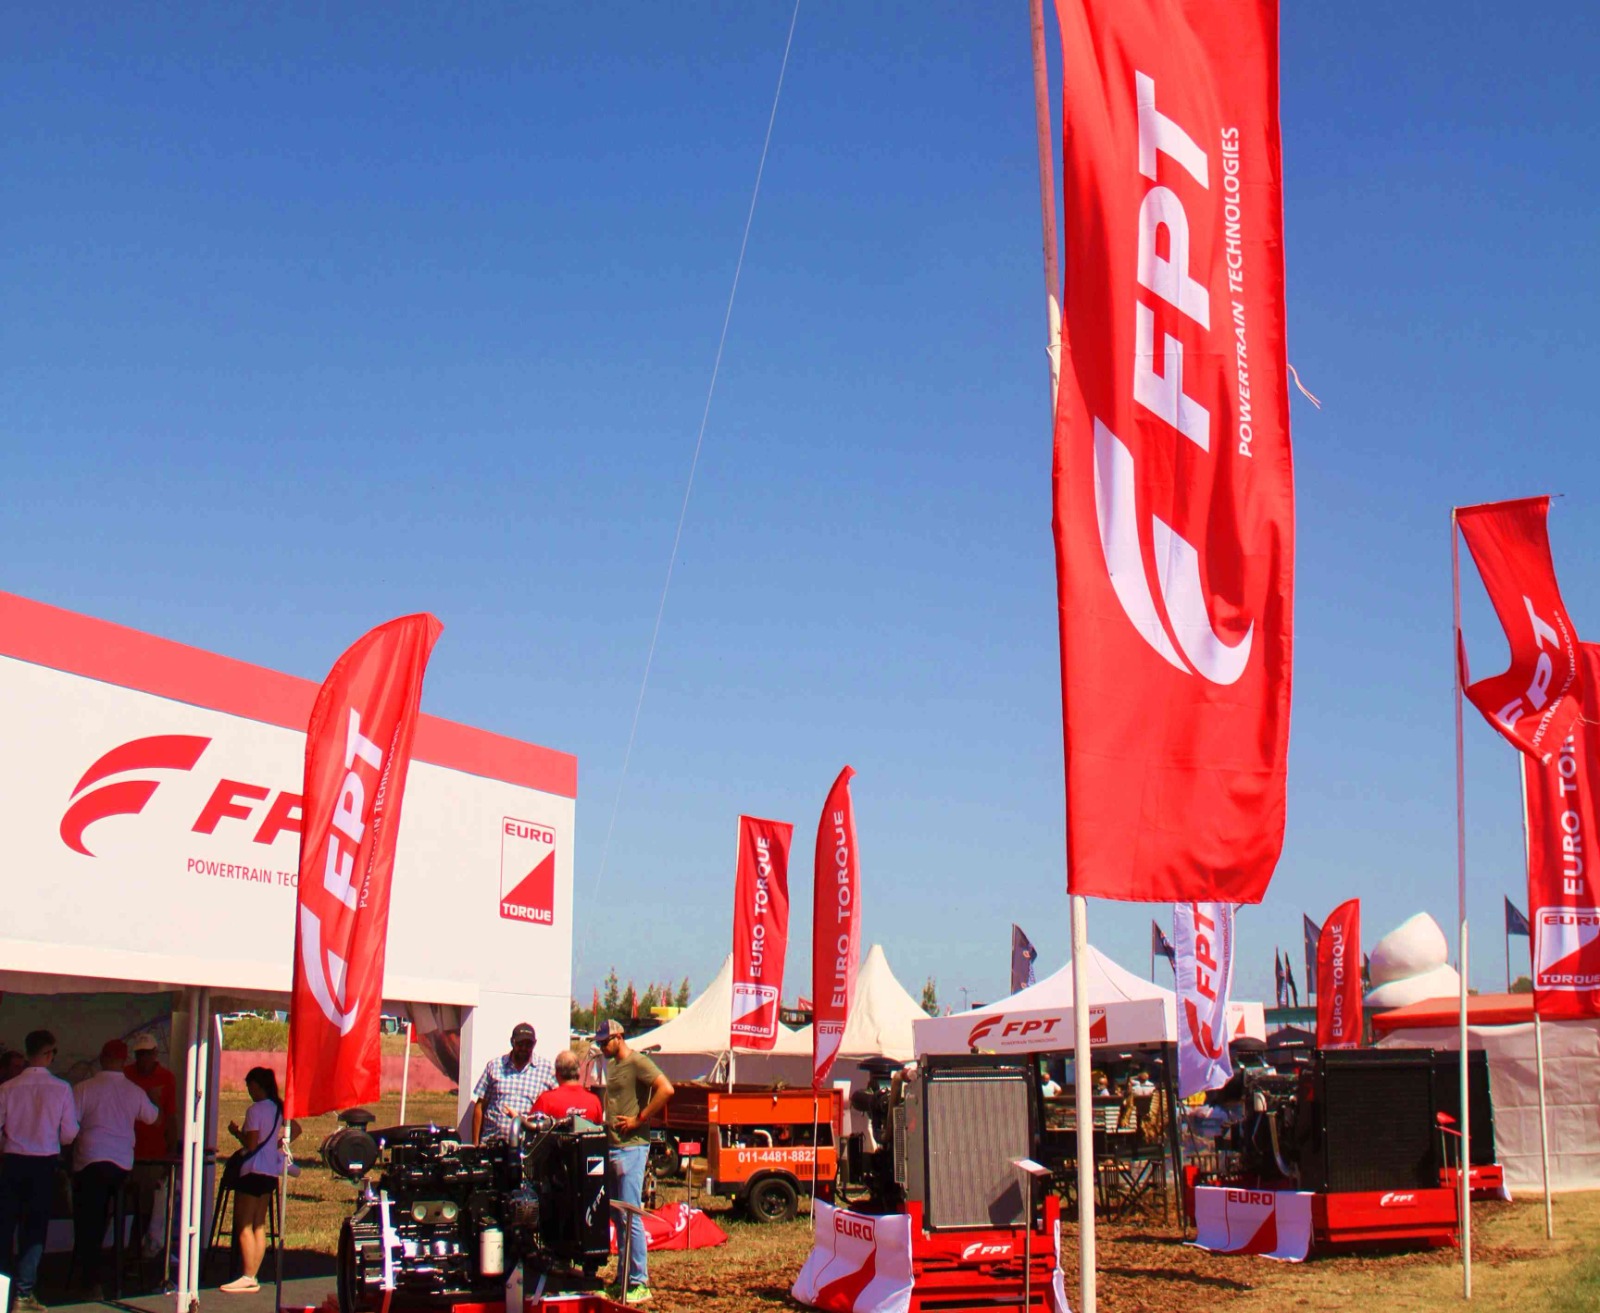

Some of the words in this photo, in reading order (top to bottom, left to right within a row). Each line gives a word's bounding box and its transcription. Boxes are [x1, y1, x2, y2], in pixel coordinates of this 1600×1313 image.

[1221, 127, 1243, 293] TECHNOLOGIES
[1134, 69, 1210, 453] FPT
[1233, 301, 1253, 458] POWERTRAIN
[1496, 594, 1560, 731] FPT
[1532, 695, 1563, 748] WERTRAIN
[1559, 734, 1577, 797] TOR
[191, 778, 302, 845] FP
[324, 707, 383, 911] FPT
[505, 823, 553, 845] EURO
[187, 858, 272, 884] POWERTRAIN
[754, 836, 771, 917] TORQUE
[833, 810, 851, 924] TORQUE
[1560, 810, 1583, 896] EURO
[502, 902, 552, 922] TORQUE
[750, 924, 765, 978] EURO
[831, 934, 849, 1008] EURO
[1192, 903, 1218, 1003] FPT
[1331, 924, 1344, 988] TORQUE
[736, 987, 773, 998] EURO
[1332, 996, 1343, 1037] EURO
[732, 1023, 770, 1034] TORQUE
[819, 1025, 843, 1035] EUR
[1002, 1018, 1062, 1037] FPT
[1228, 1190, 1273, 1205] EURO
[835, 1217, 874, 1241] EURO
[981, 1244, 1011, 1255] FPT
